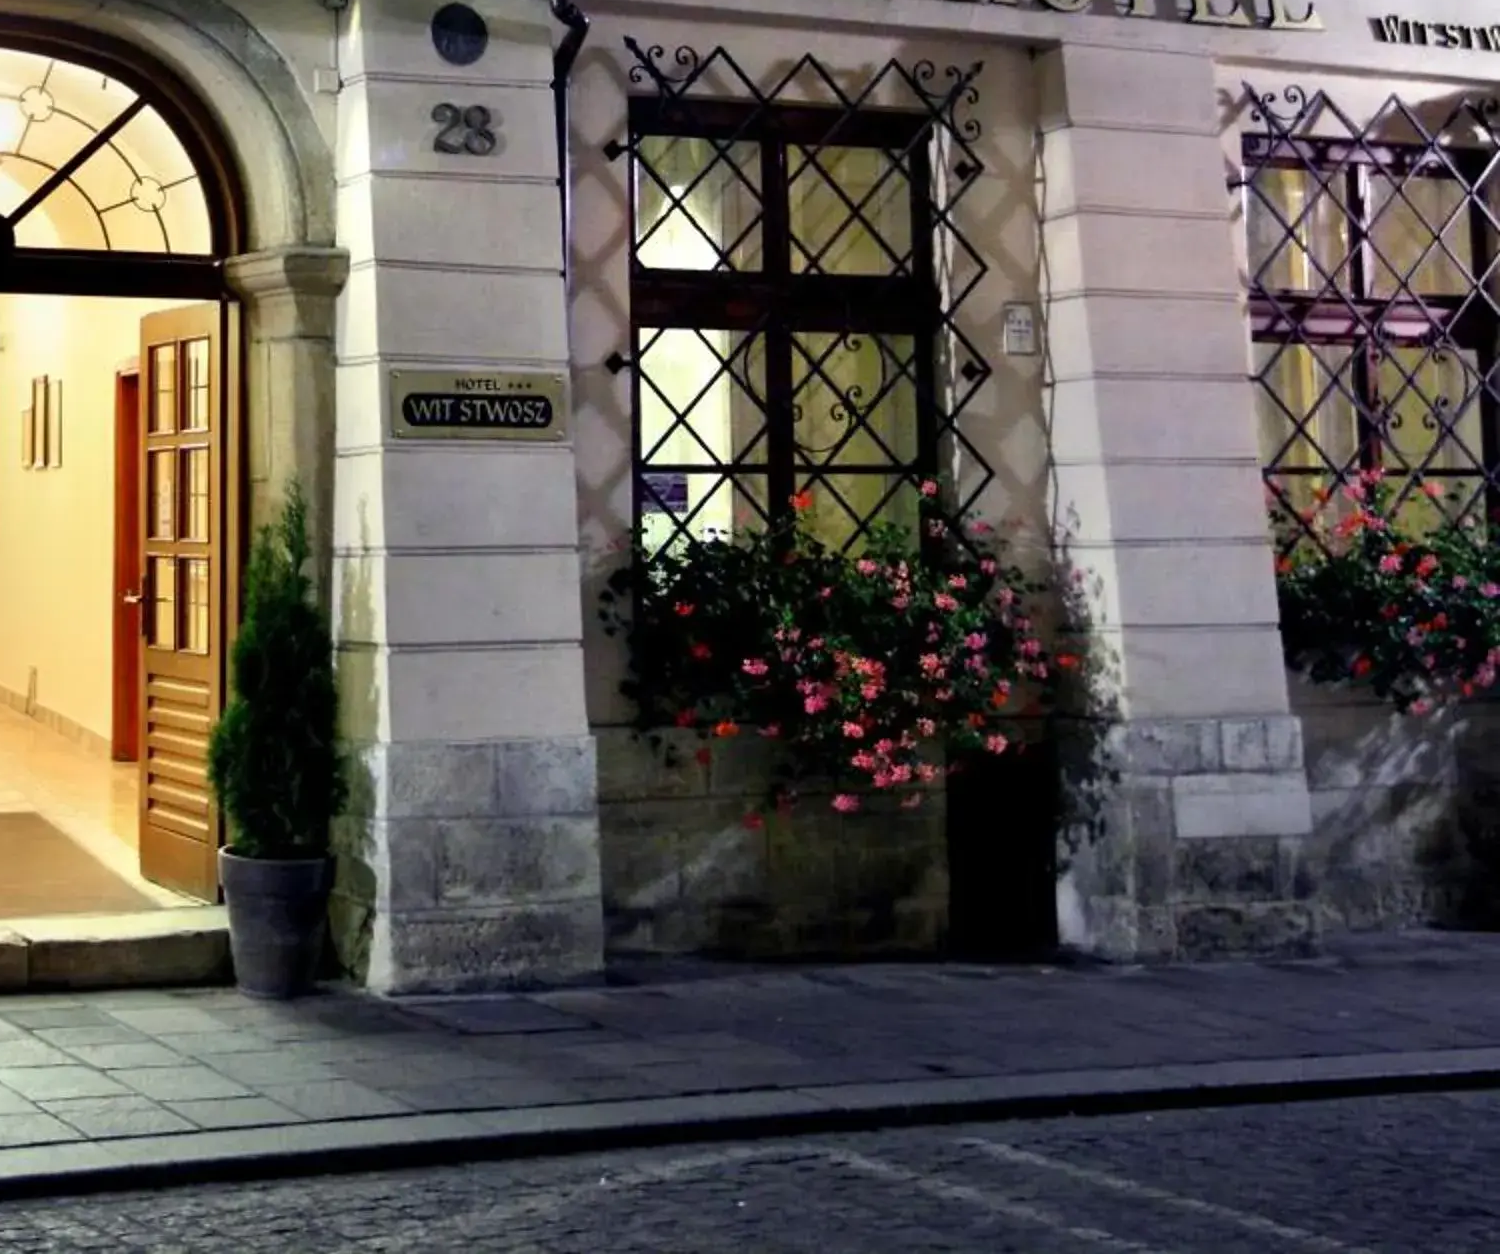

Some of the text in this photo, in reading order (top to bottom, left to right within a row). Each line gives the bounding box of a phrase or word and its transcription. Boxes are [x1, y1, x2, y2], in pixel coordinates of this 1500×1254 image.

[1368, 14, 1428, 46] WIT
[431, 102, 497, 156] 28
[454, 378, 502, 392] HOTEL
[409, 398, 546, 424] WIT STWOSZ
